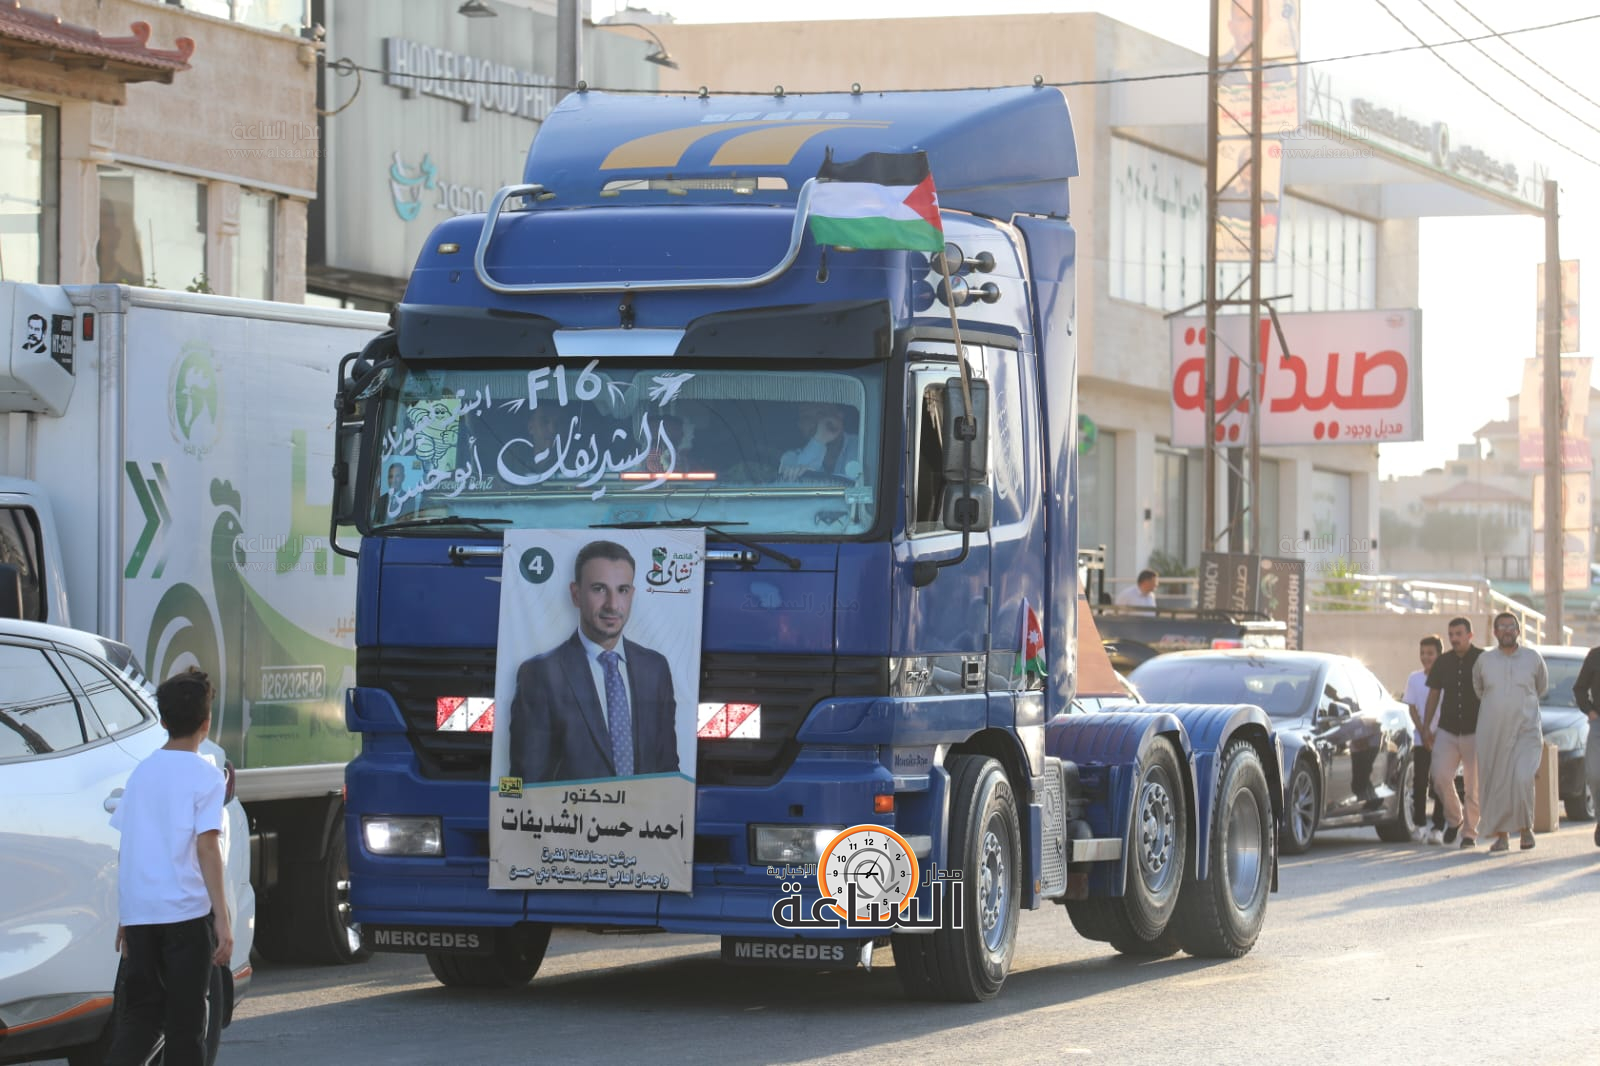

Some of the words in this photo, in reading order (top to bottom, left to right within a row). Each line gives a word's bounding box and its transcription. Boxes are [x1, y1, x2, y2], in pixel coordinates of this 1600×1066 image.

[528, 359, 602, 411] F16
[528, 555, 544, 575] 4
[261, 672, 322, 699] 026232542
[562, 789, 626, 805] الدكتور
[501, 808, 584, 839] الشديفات
[587, 816, 634, 842] حسن
[639, 813, 685, 841] أحمد
[541, 847, 568, 863] المفرق
[569, 848, 609, 864] محافظة
[609, 851, 637, 866] مرشح
[374, 930, 480, 949] MERCEDES
[734, 942, 845, 962] MERCEDES
